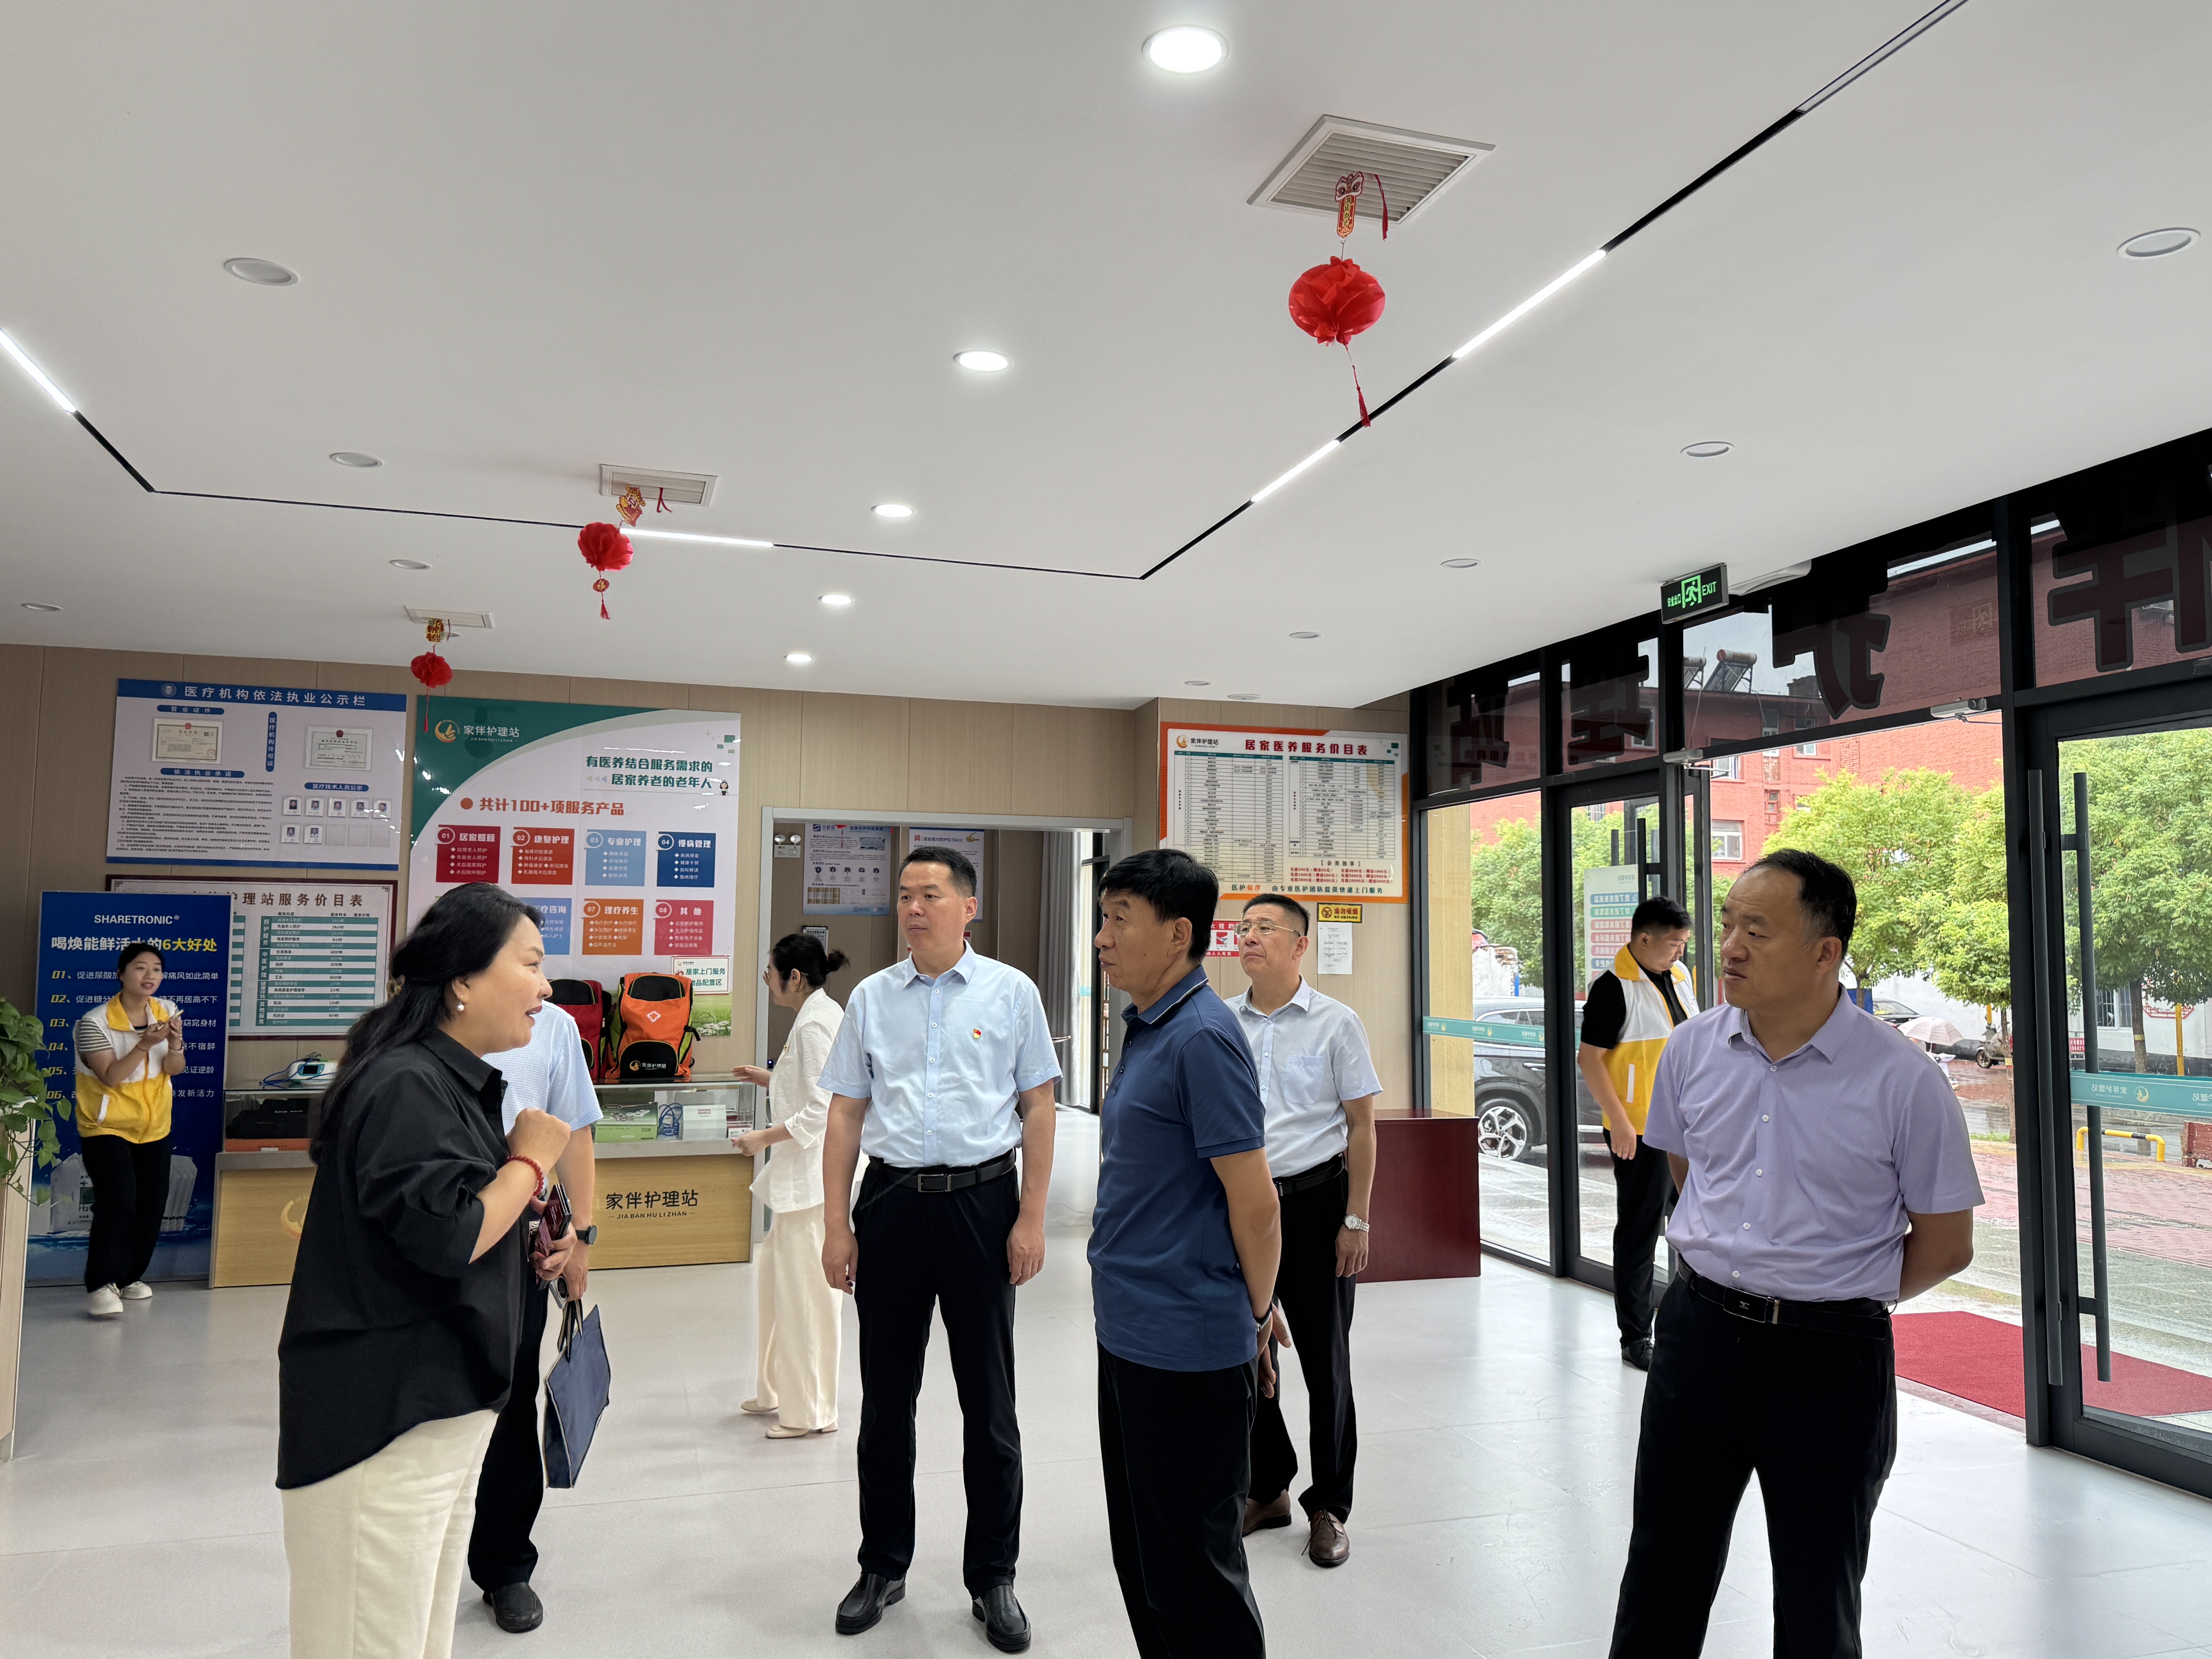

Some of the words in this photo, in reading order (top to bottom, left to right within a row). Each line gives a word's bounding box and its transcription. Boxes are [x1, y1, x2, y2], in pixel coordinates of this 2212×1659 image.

[1702, 581, 1717, 596] EXIT
[184, 686, 366, 706] 医疗机构依法执业公示栏
[464, 725, 520, 737] 家伴护理站
[267, 718, 276, 766] 医疗机构许可证
[1245, 740, 1367, 755] 居家医养服务价目表
[586, 756, 713, 772] 有医养结合服务需求的
[611, 774, 712, 788] 居家养老的老年人
[480, 798, 624, 816] 共计100+项服务产品
[459, 833, 495, 842] 居家照顾
[534, 835, 569, 844] 康复护理
[608, 838, 641, 846] 专业护理
[678, 839, 711, 848] 慢病管理
[233, 892, 363, 907] 理站服务价目表
[537, 905, 566, 914] 疗咨询
[605, 906, 639, 914] 理疗养生
[172, 1089, 214, 1097] 发新活力
[606, 1189, 698, 1210] 家伴护理站
